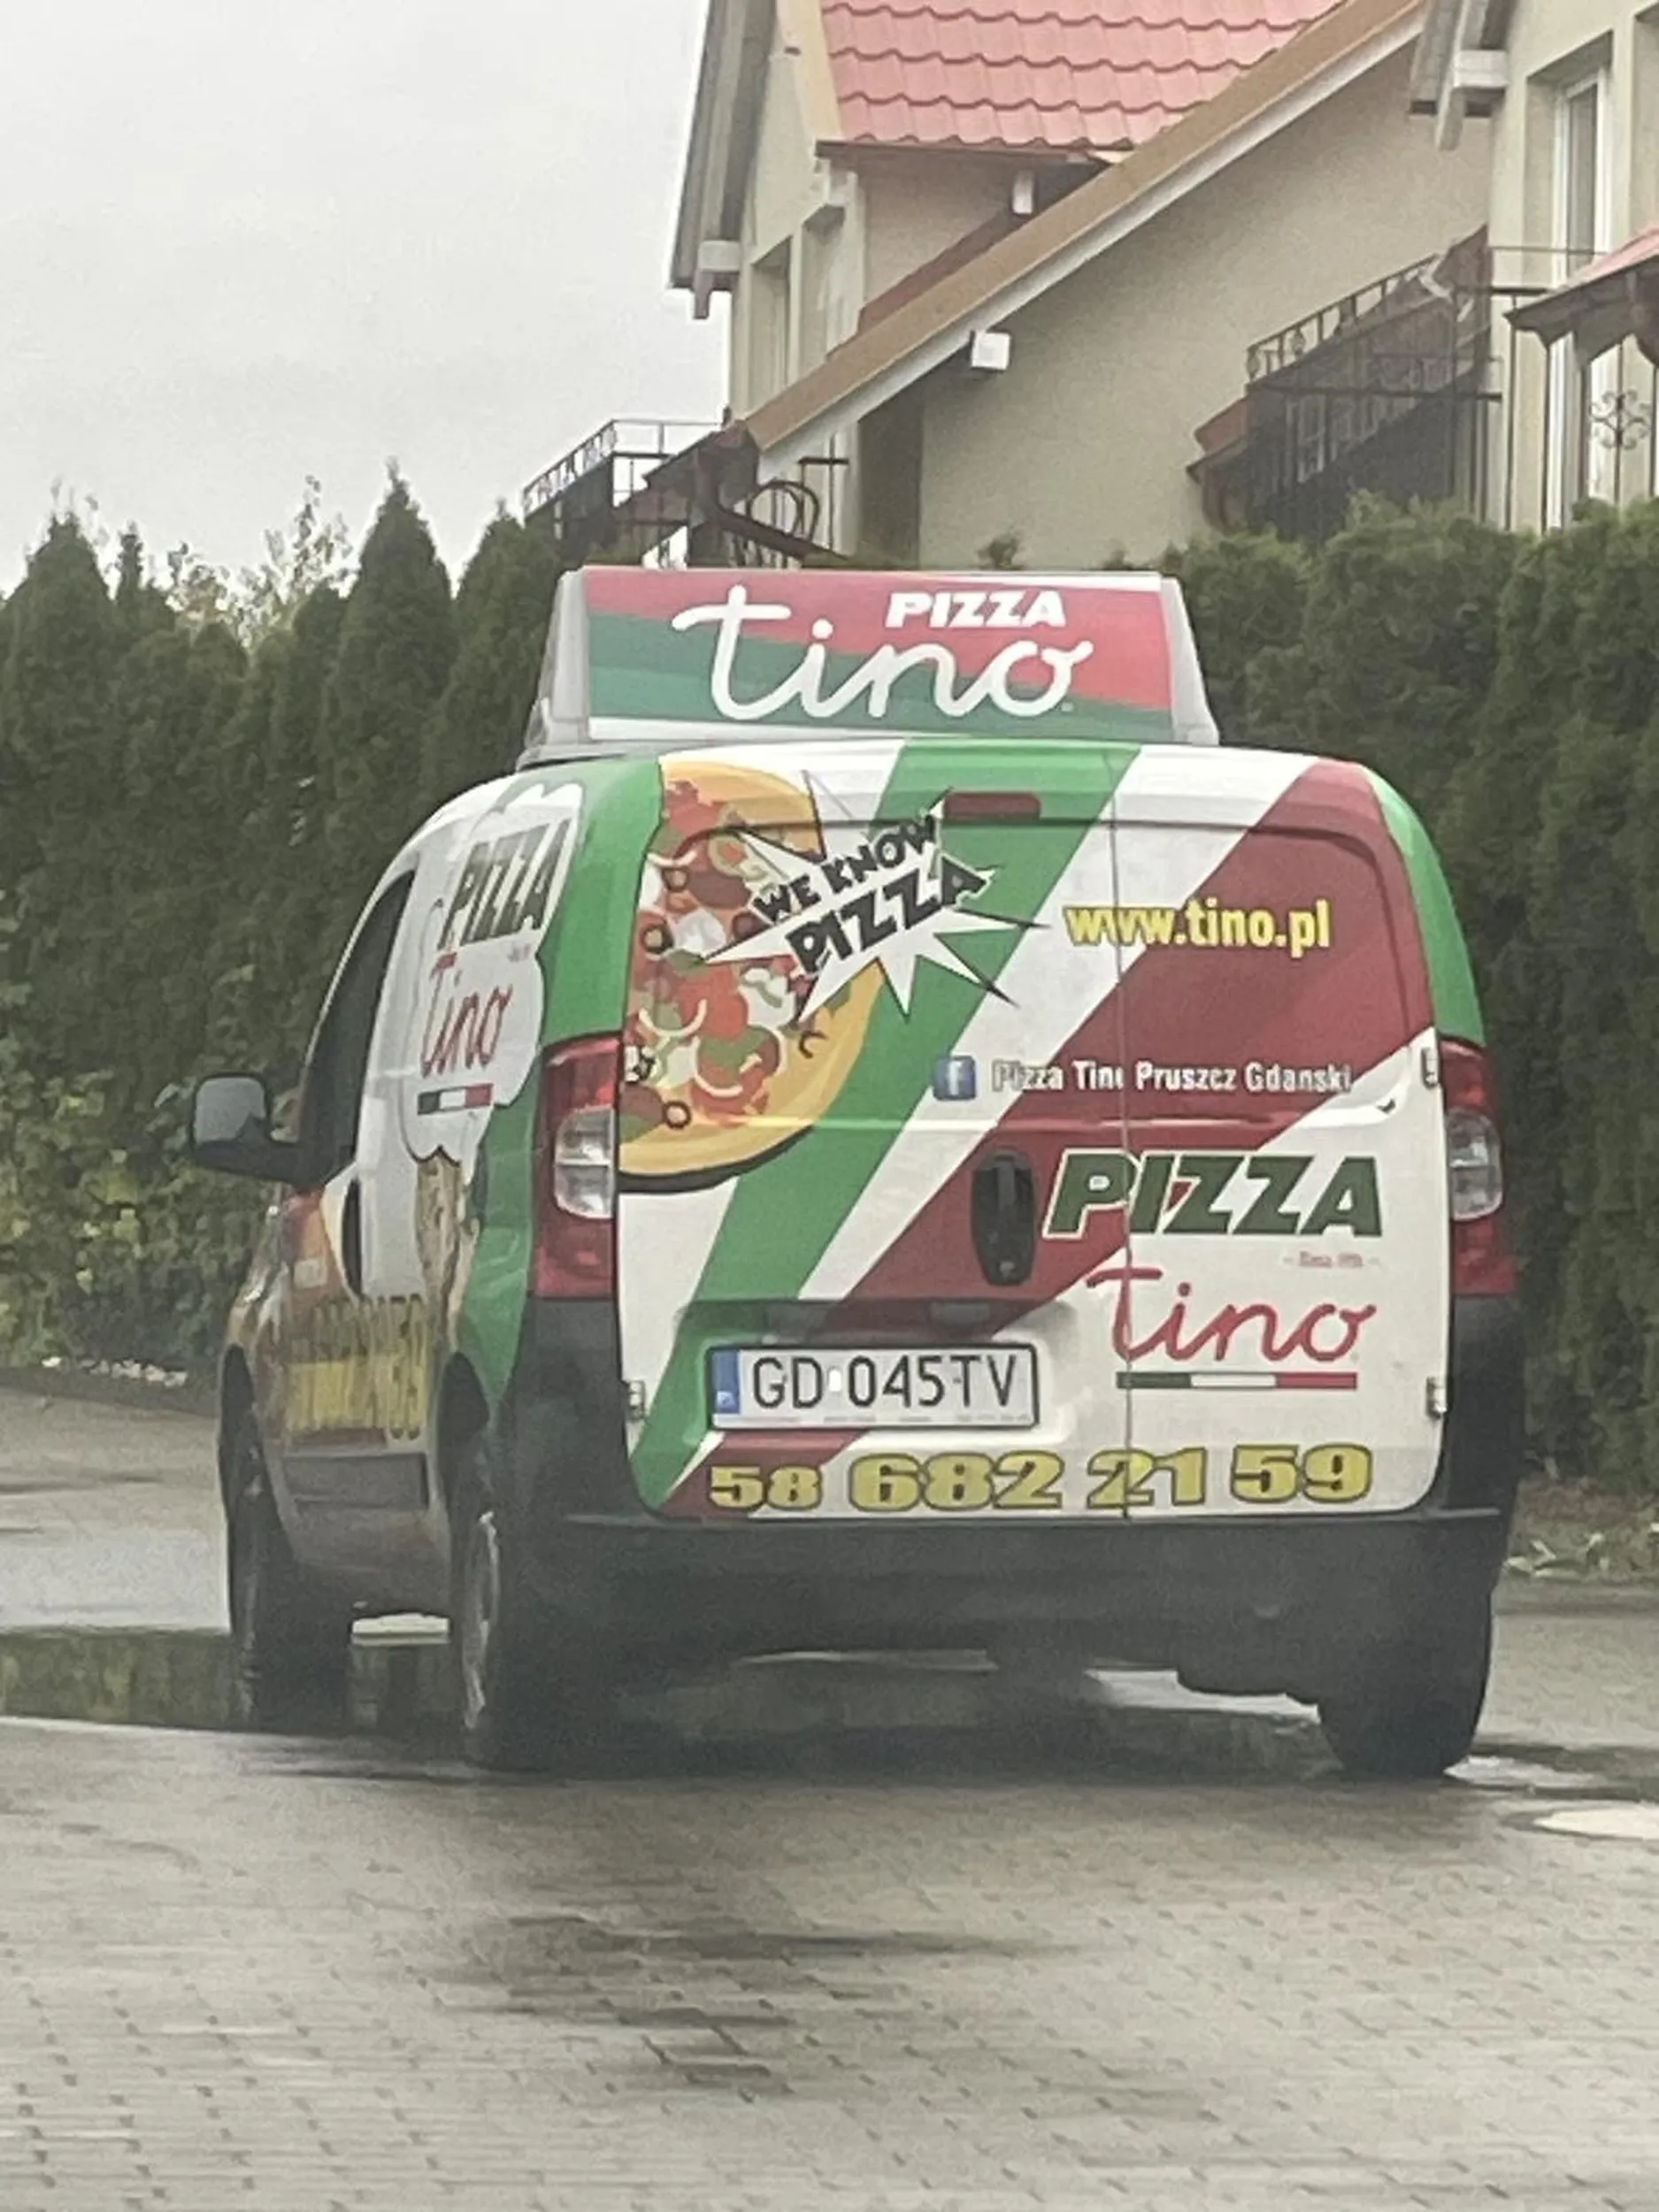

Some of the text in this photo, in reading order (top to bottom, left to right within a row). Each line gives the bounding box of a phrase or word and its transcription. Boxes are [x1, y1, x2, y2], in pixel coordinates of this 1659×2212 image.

[672, 585, 1094, 721] tino
[886, 591, 1066, 628] PIZZA
[437, 818, 572, 951] PIZZA
[753, 814, 936, 924] WE KNOW
[786, 856, 987, 973] PIZZA
[1064, 898, 1332, 957] www.tino.pl
[992, 1059, 1064, 1092] Pizza
[1135, 1060, 1237, 1091] Pruszcz
[1244, 1060, 1352, 1093] Gdanski
[1046, 1150, 1382, 1237] PIZZA
[1087, 1267, 1377, 1361] tino
[752, 1355, 823, 1409] GD
[848, 1354, 1018, 1408] 045TV
[710, 1443, 1373, 1511] 58 682 21 59
